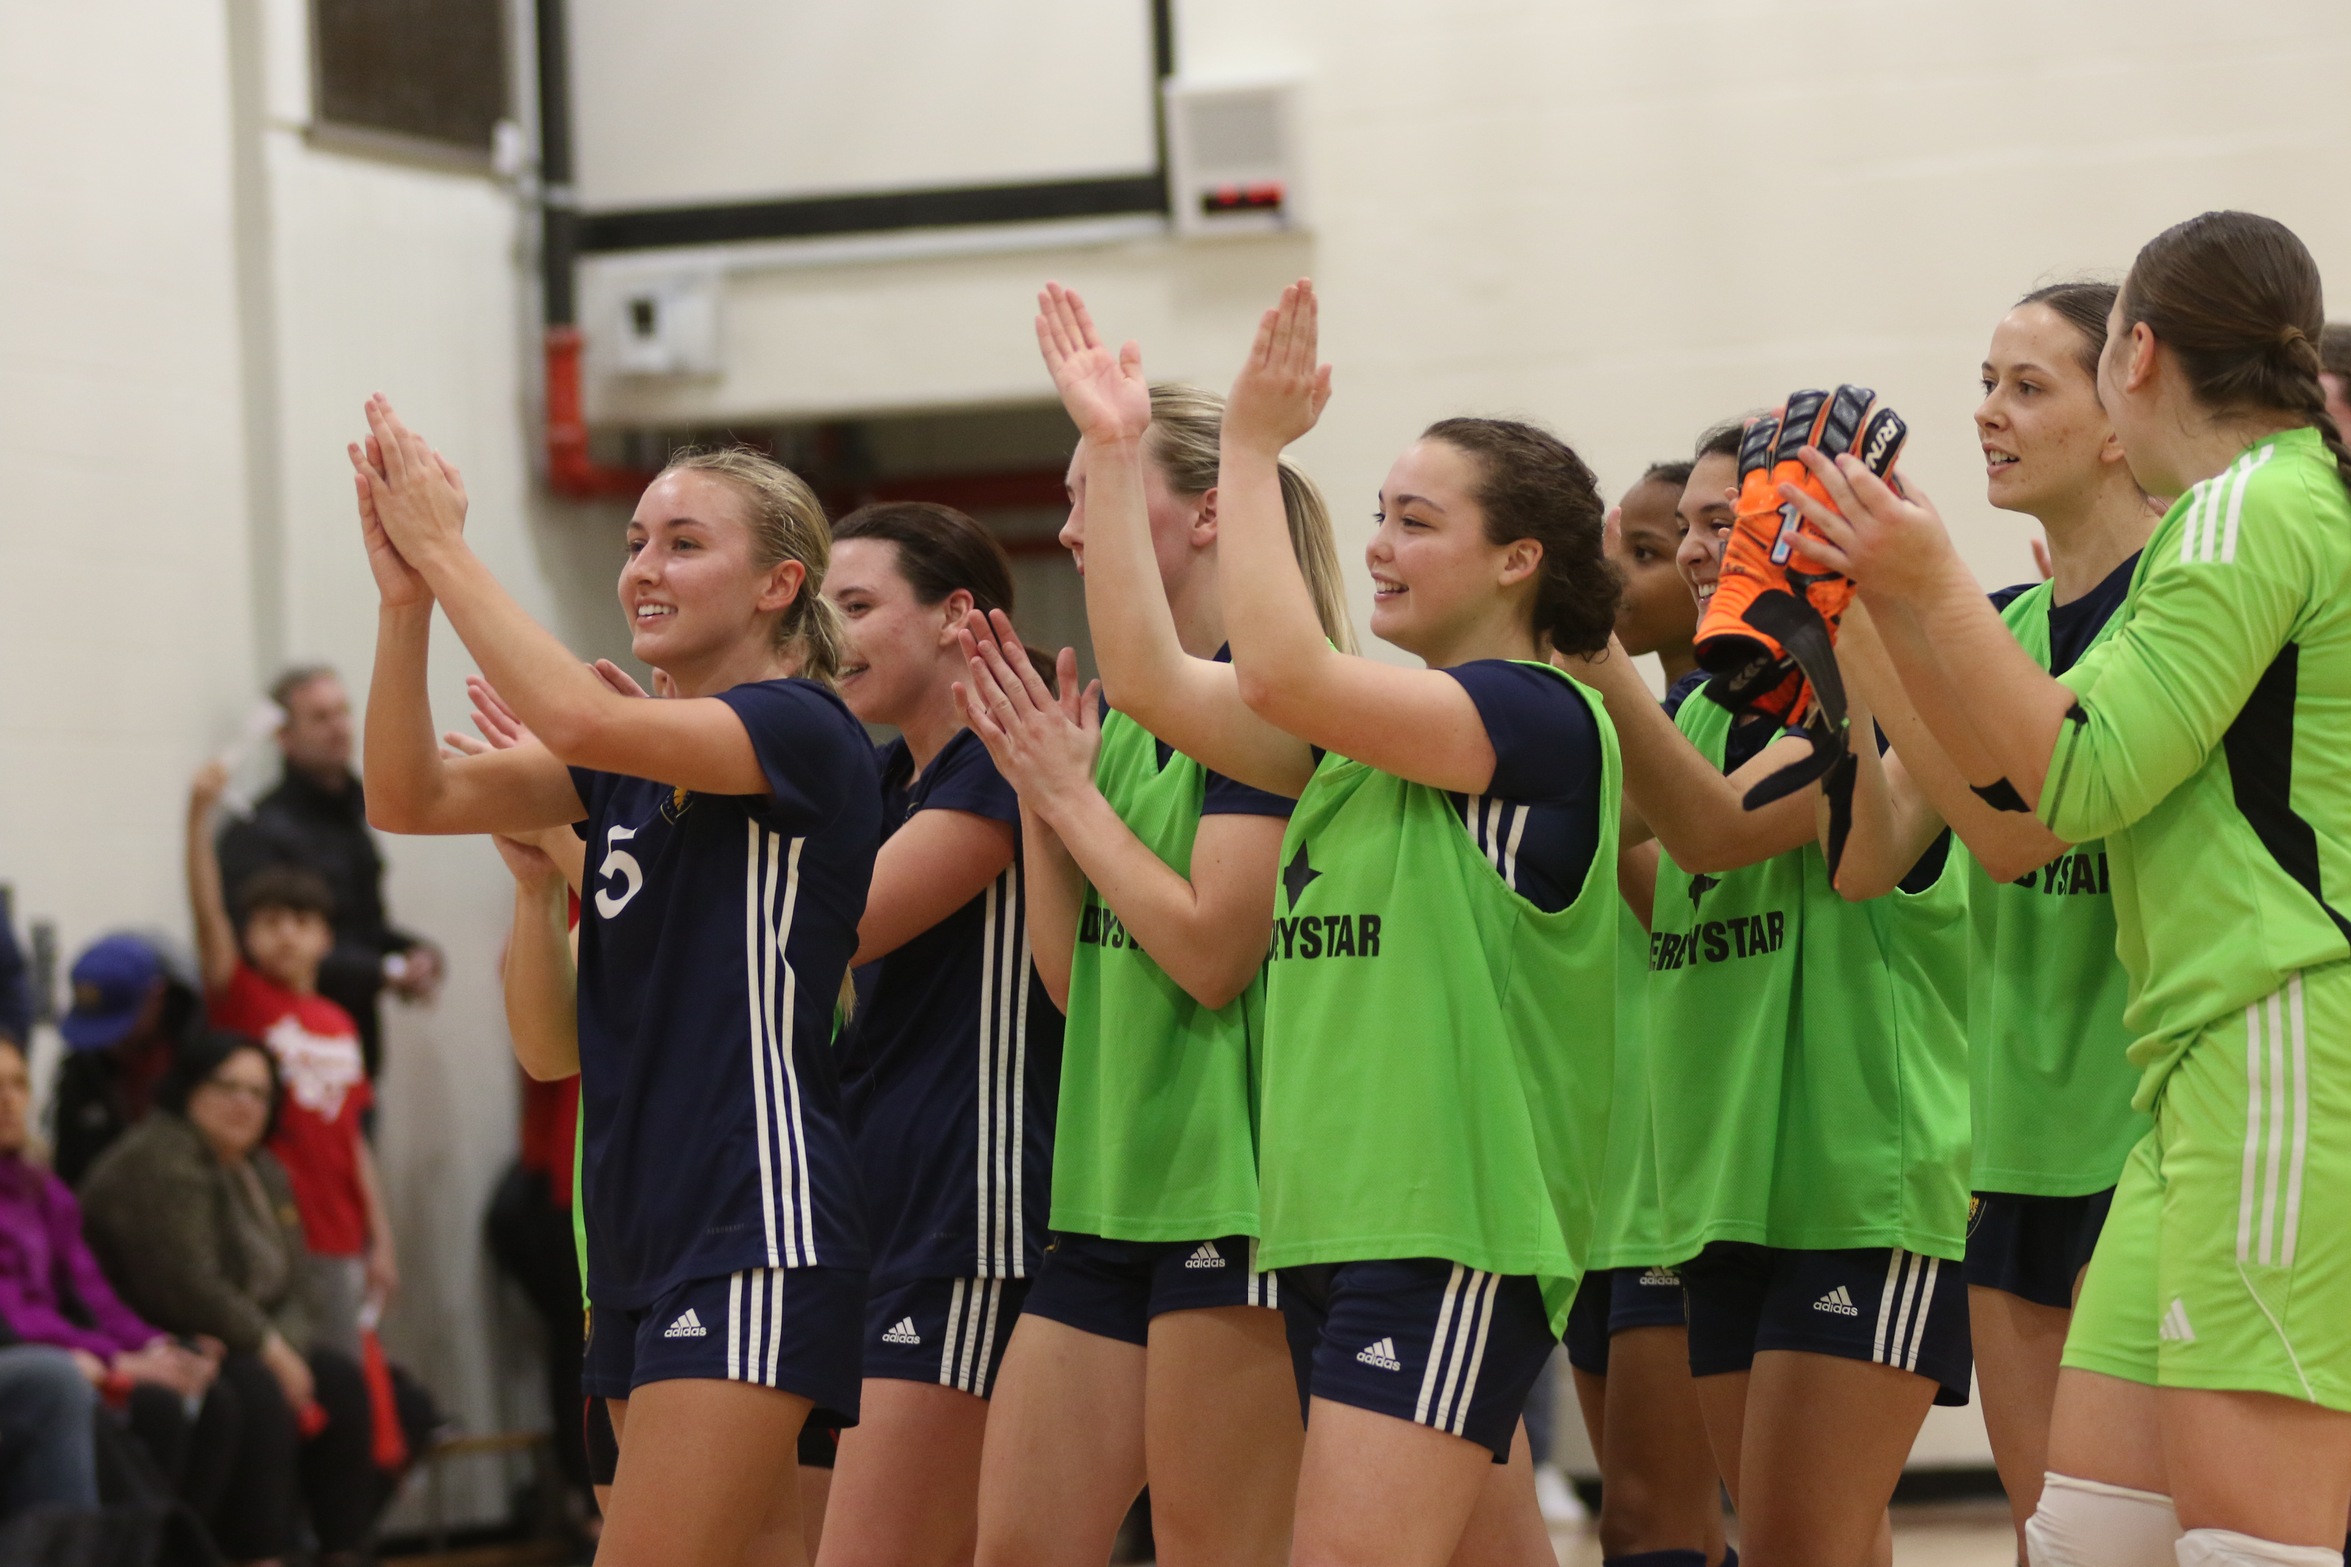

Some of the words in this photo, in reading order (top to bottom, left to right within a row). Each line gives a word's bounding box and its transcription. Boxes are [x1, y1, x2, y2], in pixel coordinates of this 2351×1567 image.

[595, 825, 643, 919] 5
[1268, 914, 1381, 961] YSTAR
[1185, 1257, 1226, 1268] adidas
[1640, 1275, 1680, 1286] adidas
[1813, 1301, 1858, 1316] adidas
[664, 1326, 707, 1337] adidas
[882, 1332, 921, 1344] adidas
[1356, 1351, 1401, 1371] adidas
